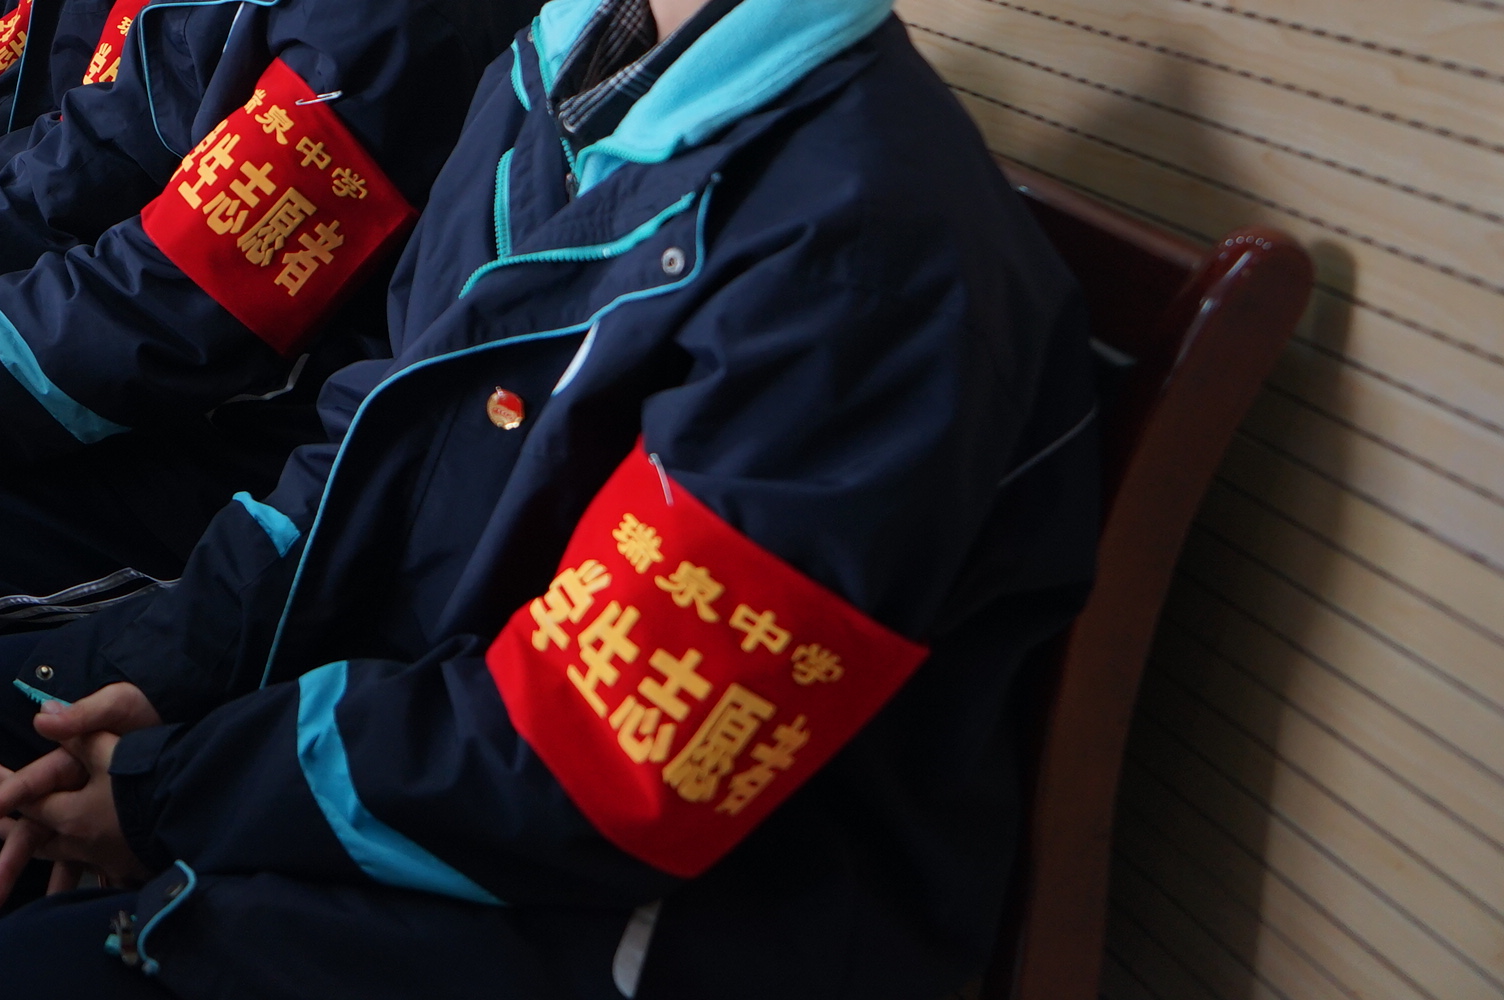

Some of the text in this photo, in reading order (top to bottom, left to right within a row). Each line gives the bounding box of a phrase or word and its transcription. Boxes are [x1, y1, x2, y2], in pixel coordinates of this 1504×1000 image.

[530, 559, 810, 816] 学生志愿者
[612, 512, 844, 686] 瑞泉中学
